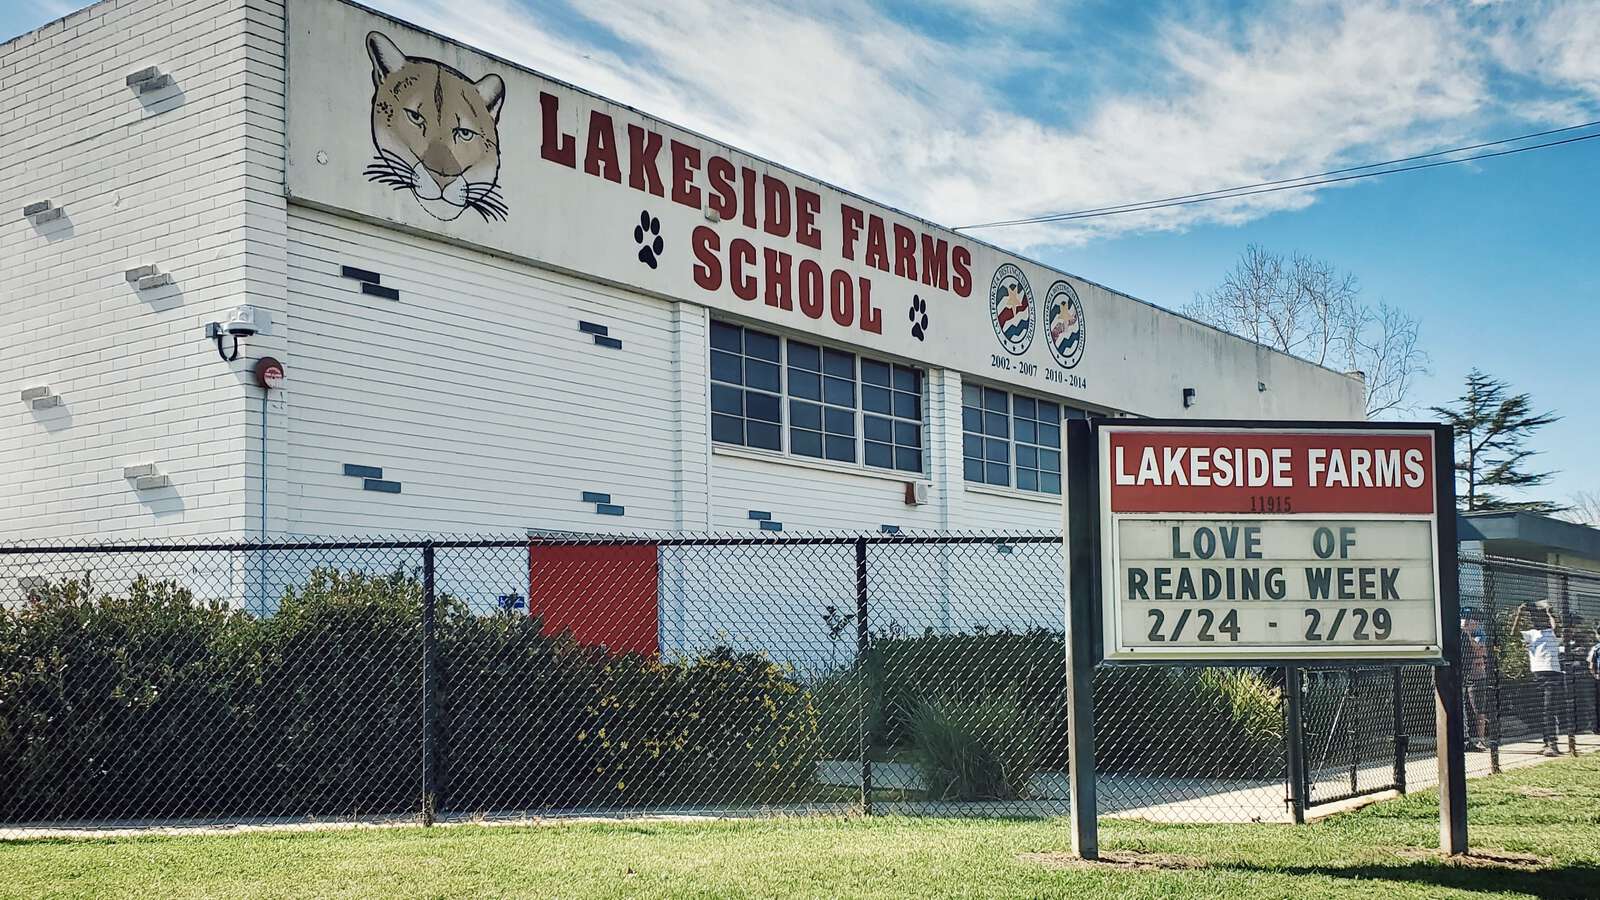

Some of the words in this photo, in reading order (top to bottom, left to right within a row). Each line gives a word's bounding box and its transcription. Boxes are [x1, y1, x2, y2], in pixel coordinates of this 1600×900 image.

[539, 91, 822, 251] LAKESIDE
[840, 203, 973, 298] FARMS
[691, 225, 882, 335] SCHOOL
[991, 354, 1010, 371] 2002
[1019, 361, 1038, 376] 2007
[1045, 368, 1063, 383] 2010
[1069, 374, 1087, 389] 2014
[1115, 446, 1294, 487] LAKESIDE
[1307, 448, 1426, 488] FARMS
[1250, 496, 1292, 512] 11915
[1172, 526, 1263, 559] LOVE
[1312, 526, 1357, 559] OF
[1128, 567, 1287, 601] READING
[1304, 567, 1401, 600] WEEK
[1148, 609, 1241, 642] 2/24
[1304, 608, 1392, 642] 2/29
